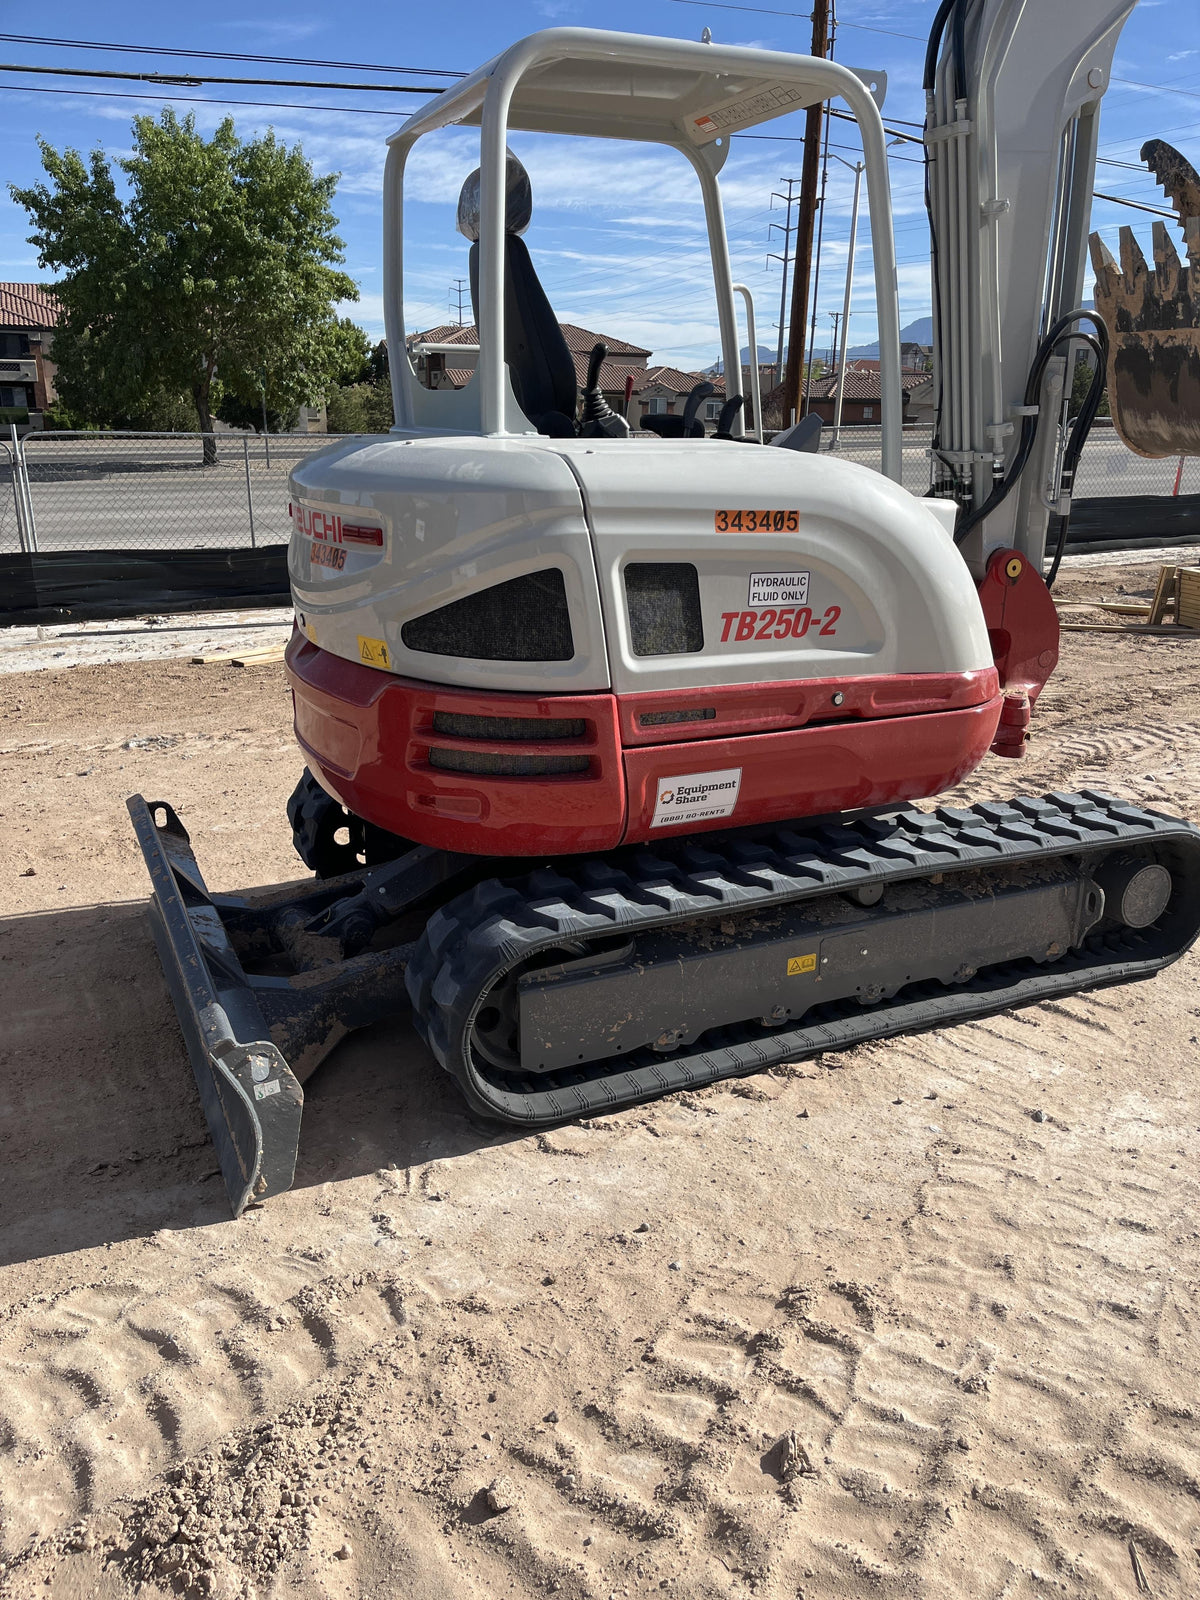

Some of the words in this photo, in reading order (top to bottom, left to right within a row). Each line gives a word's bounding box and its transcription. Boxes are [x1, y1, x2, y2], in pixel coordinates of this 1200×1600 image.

[717, 510, 798, 531] 343405
[753, 577, 807, 587] HYDRAULIC
[752, 592, 779, 602] FLUID
[781, 591, 805, 601] ONLY
[720, 606, 841, 642] TB250-2
[677, 780, 736, 795] Equipment
[675, 794, 708, 805] Share
